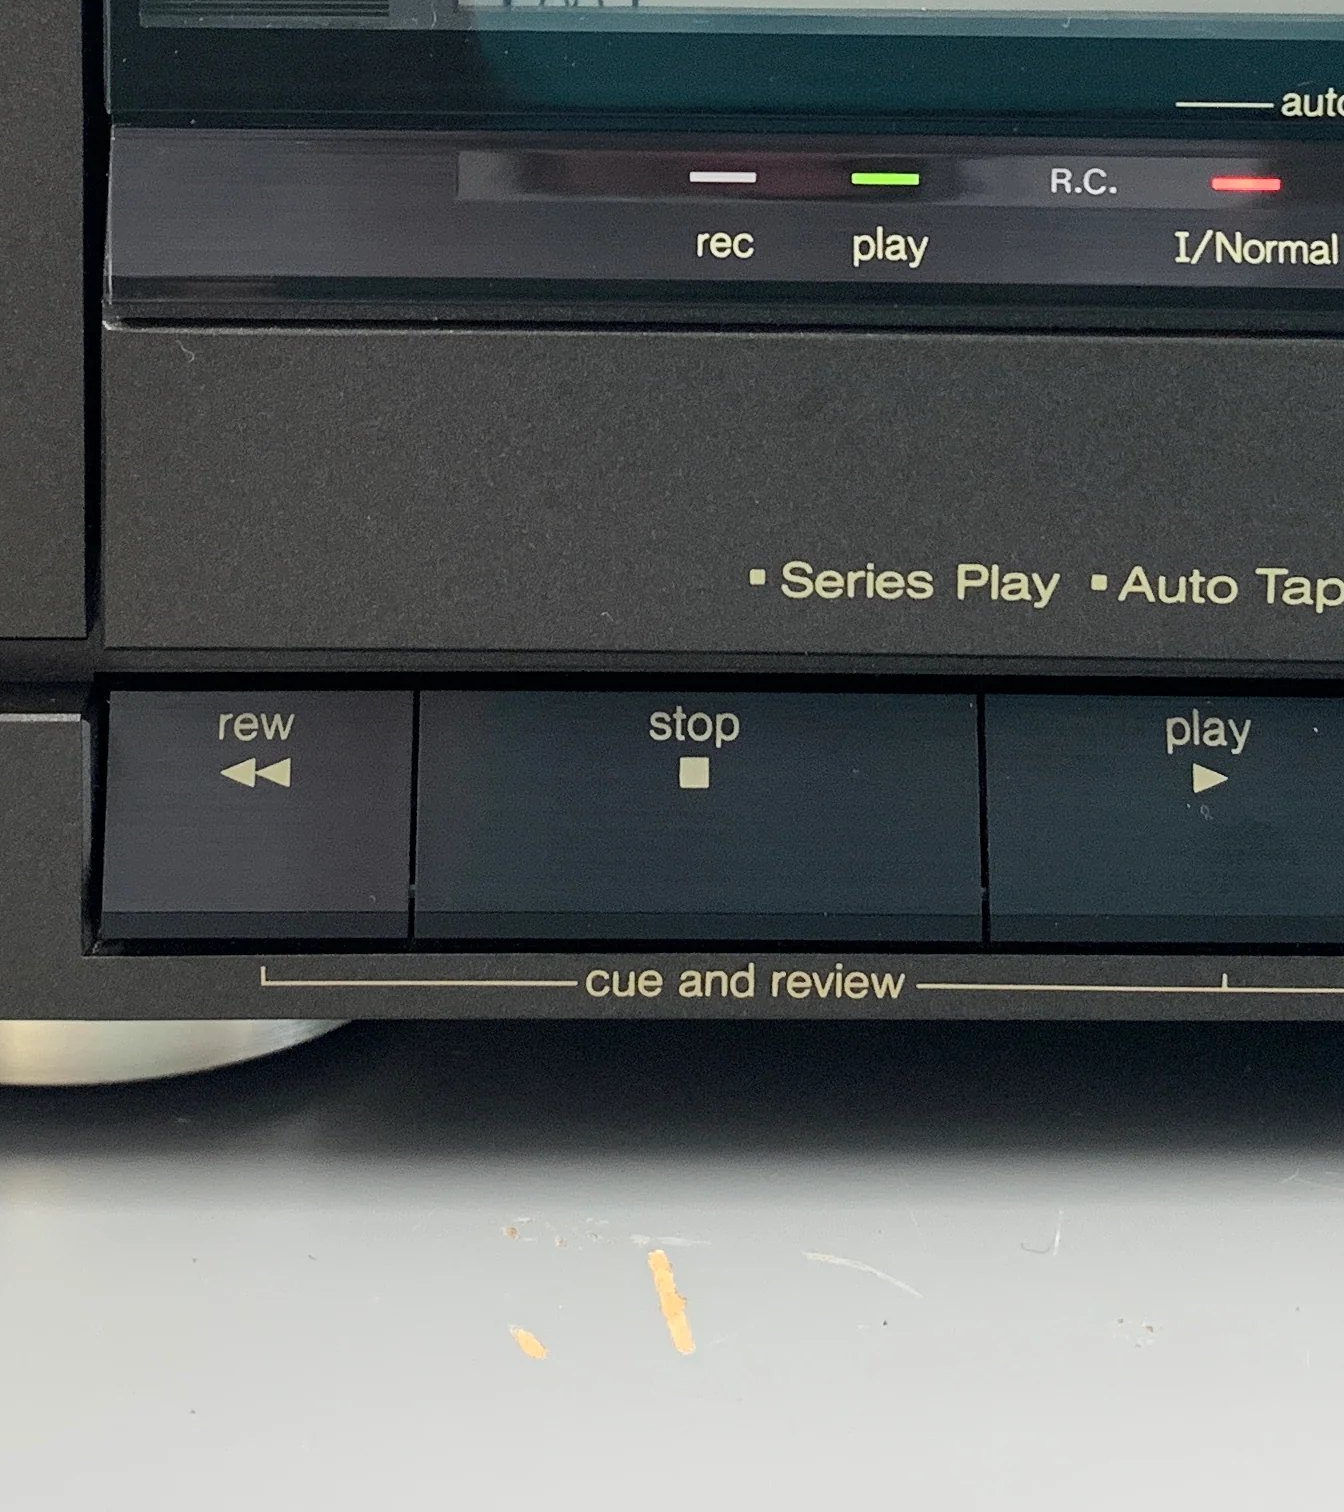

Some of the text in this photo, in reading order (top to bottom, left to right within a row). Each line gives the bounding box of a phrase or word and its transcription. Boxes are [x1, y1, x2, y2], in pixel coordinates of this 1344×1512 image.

[1051, 168, 1117, 195] R.C.
[697, 233, 754, 258] rec
[854, 226, 928, 268] play
[1175, 230, 1338, 265] I/Normal
[781, 561, 933, 599] Series
[957, 564, 1060, 608] Play
[1118, 566, 1238, 604] Auto
[219, 713, 294, 741] rew
[650, 706, 739, 748] stop
[1167, 709, 1251, 754] play
[586, 963, 905, 999] cue and review
